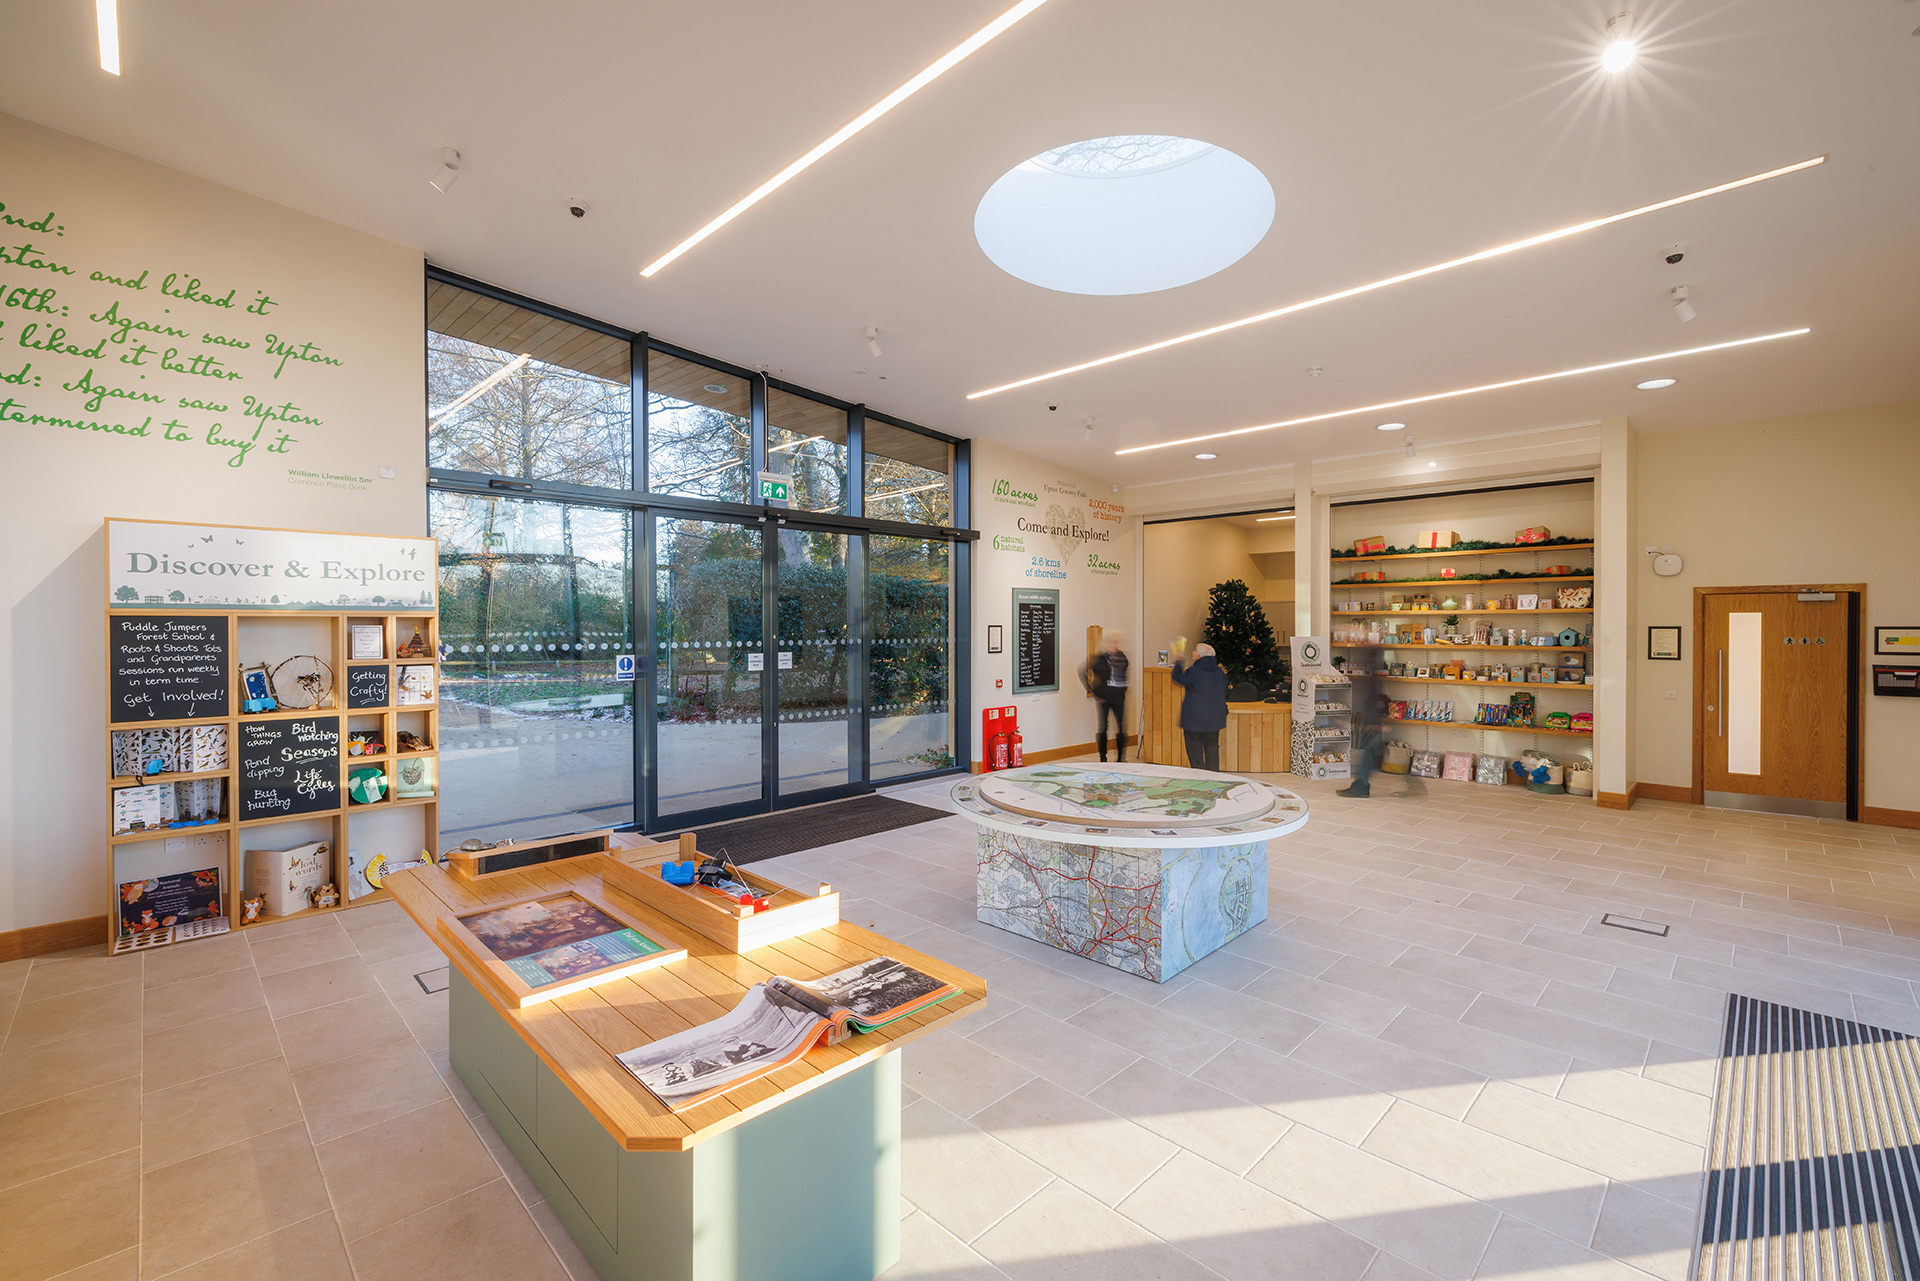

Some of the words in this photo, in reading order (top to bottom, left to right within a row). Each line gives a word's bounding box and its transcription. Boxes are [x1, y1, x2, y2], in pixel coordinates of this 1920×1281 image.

[0, 203, 64, 236] nd:
[89, 270, 148, 290] and
[161, 273, 236, 308] liked
[247, 290, 279, 315] it
[89, 301, 190, 344] Again
[202, 333, 251, 349] saw
[265, 334, 344, 379] Upton
[19, 323, 107, 359] liked
[120, 339, 158, 366] it
[161, 348, 244, 381] better
[62, 368, 166, 413] Again
[179, 396, 229, 412] saw
[243, 395, 324, 441] Upton
[0, 398, 152, 438] termined
[162, 419, 193, 442] to
[206, 422, 256, 468] buy
[267, 429, 299, 454] it
[288, 469, 320, 478] William
[322, 473, 357, 482] Llewellin
[288, 477, 324, 487] Common
[326, 481, 347, 489] Place
[992, 479, 1010, 496] 160
[1011, 490, 1038, 502] acres
[1089, 499, 1107, 510] 2,000
[1108, 504, 1125, 513] years
[1093, 511, 1100, 519] of
[1100, 511, 1122, 524] history
[1018, 517, 1048, 534] Come
[1051, 524, 1069, 536] and
[1072, 525, 1110, 543] Explore!
[993, 535, 1000, 551] 6
[1001, 536, 1024, 545] natural
[1001, 543, 1026, 553] habitats
[1032, 557, 1044, 566] 2.6
[1046, 559, 1061, 568] kms
[1088, 554, 1099, 568] 32
[1099, 562, 1121, 570] acres
[127, 552, 274, 577] Discover
[284, 560, 310, 579] &
[320, 561, 426, 587] Explore
[1026, 569, 1033, 577] of
[1034, 569, 1067, 579] shoreline
[121, 621, 159, 632] Puddle
[164, 621, 207, 633] Jumpers
[137, 633, 169, 641] Forest
[172, 632, 205, 641] School
[121, 645, 152, 654] Roots
[164, 644, 199, 653] Shoots
[203, 644, 222, 653] Tots
[151, 655, 217, 665] Grandparents
[188, 665, 220, 676] weekly
[145, 678, 171, 686] term
[352, 672, 386, 686] Getting
[123, 692, 152, 708] Get
[163, 689, 224, 701] Involved!
[350, 684, 388, 702] Crafty!
[292, 721, 316, 735] Bird
[247, 739, 274, 747] GROW
[298, 730, 339, 745] watching
[281, 747, 338, 762] Seasons
[245, 756, 270, 770] Pond
[247, 766, 285, 781] dipping
[294, 768, 322, 787] Life
[255, 789, 278, 800] Bug
[247, 798, 291, 811] hunting
[296, 862, 323, 876] words
[301, 857, 316, 869] lost
